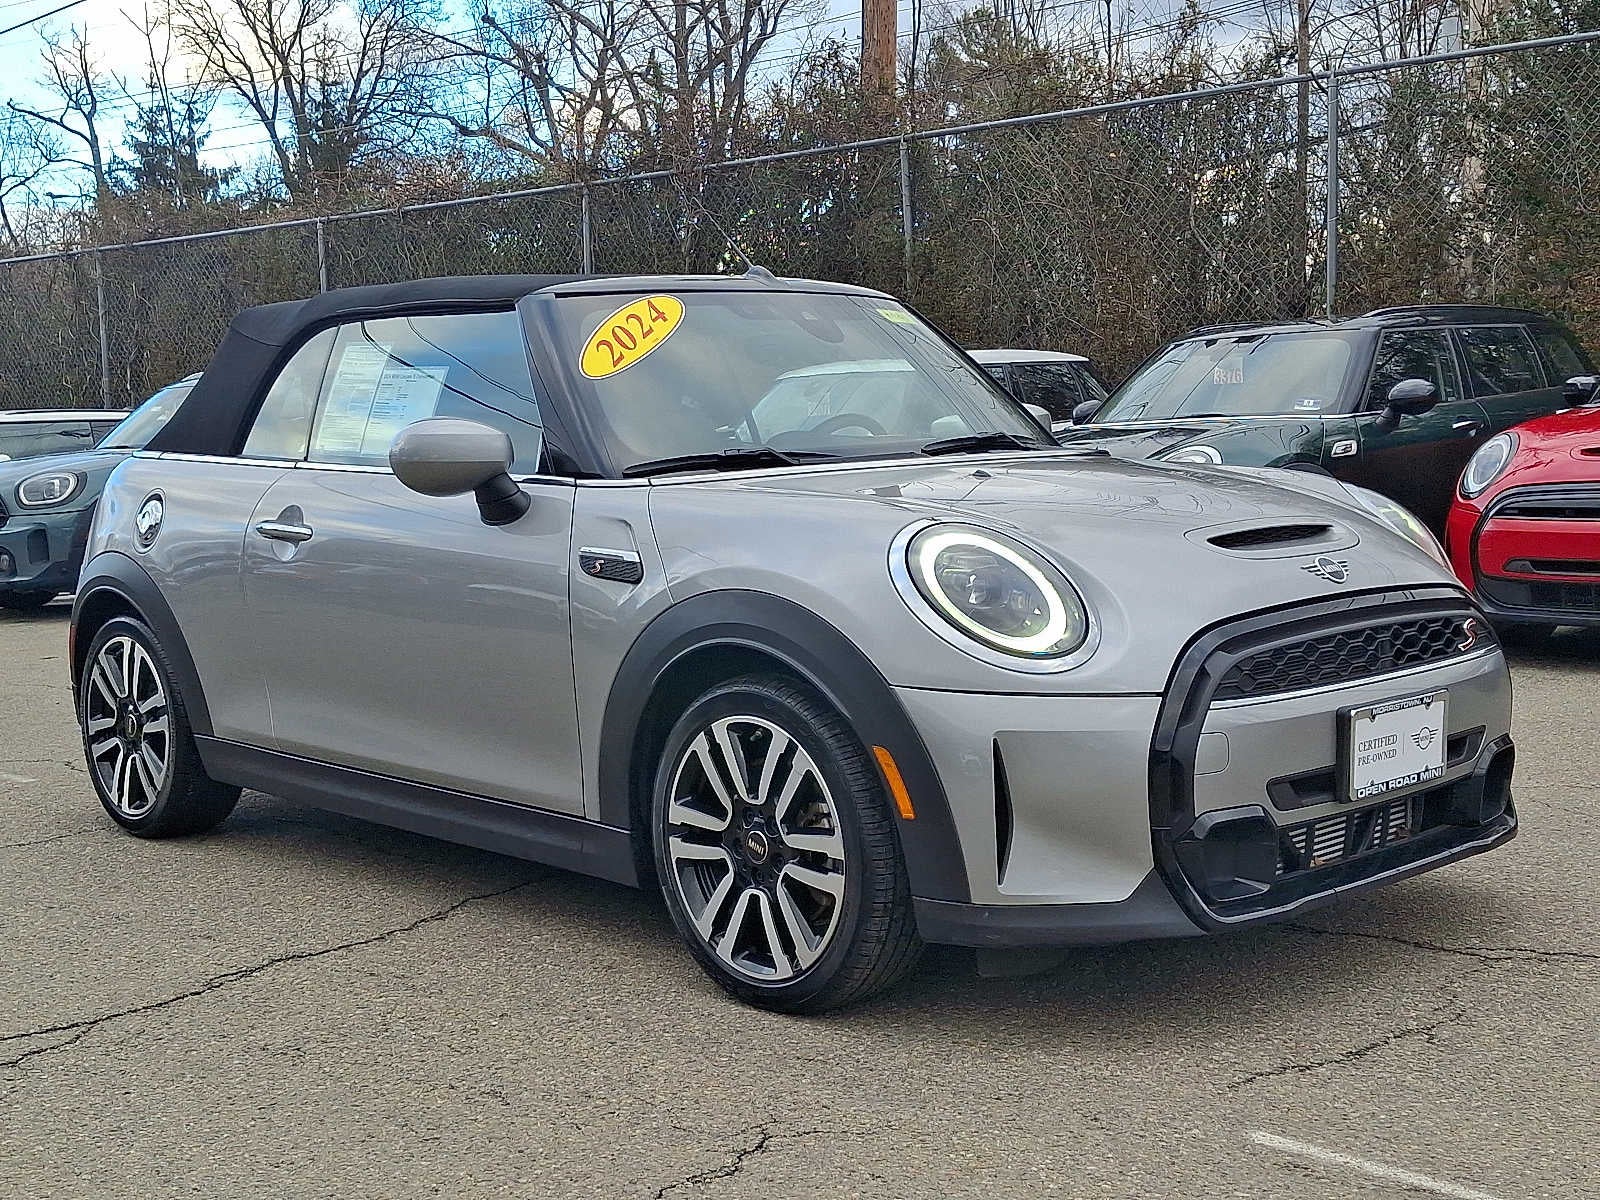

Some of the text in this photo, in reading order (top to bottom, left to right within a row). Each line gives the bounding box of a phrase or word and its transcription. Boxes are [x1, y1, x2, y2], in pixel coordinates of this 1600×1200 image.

[596, 299, 668, 368] 2024
[590, 559, 605, 574] S
[1457, 617, 1477, 652] S
[1422, 695, 1434, 704] NJ
[1358, 734, 1398, 752] CERTIFIED
[1357, 748, 1397, 767] PRE-OWNED
[1357, 767, 1443, 799] OPEN ROAD MINI
[748, 838, 764, 856] MINI
